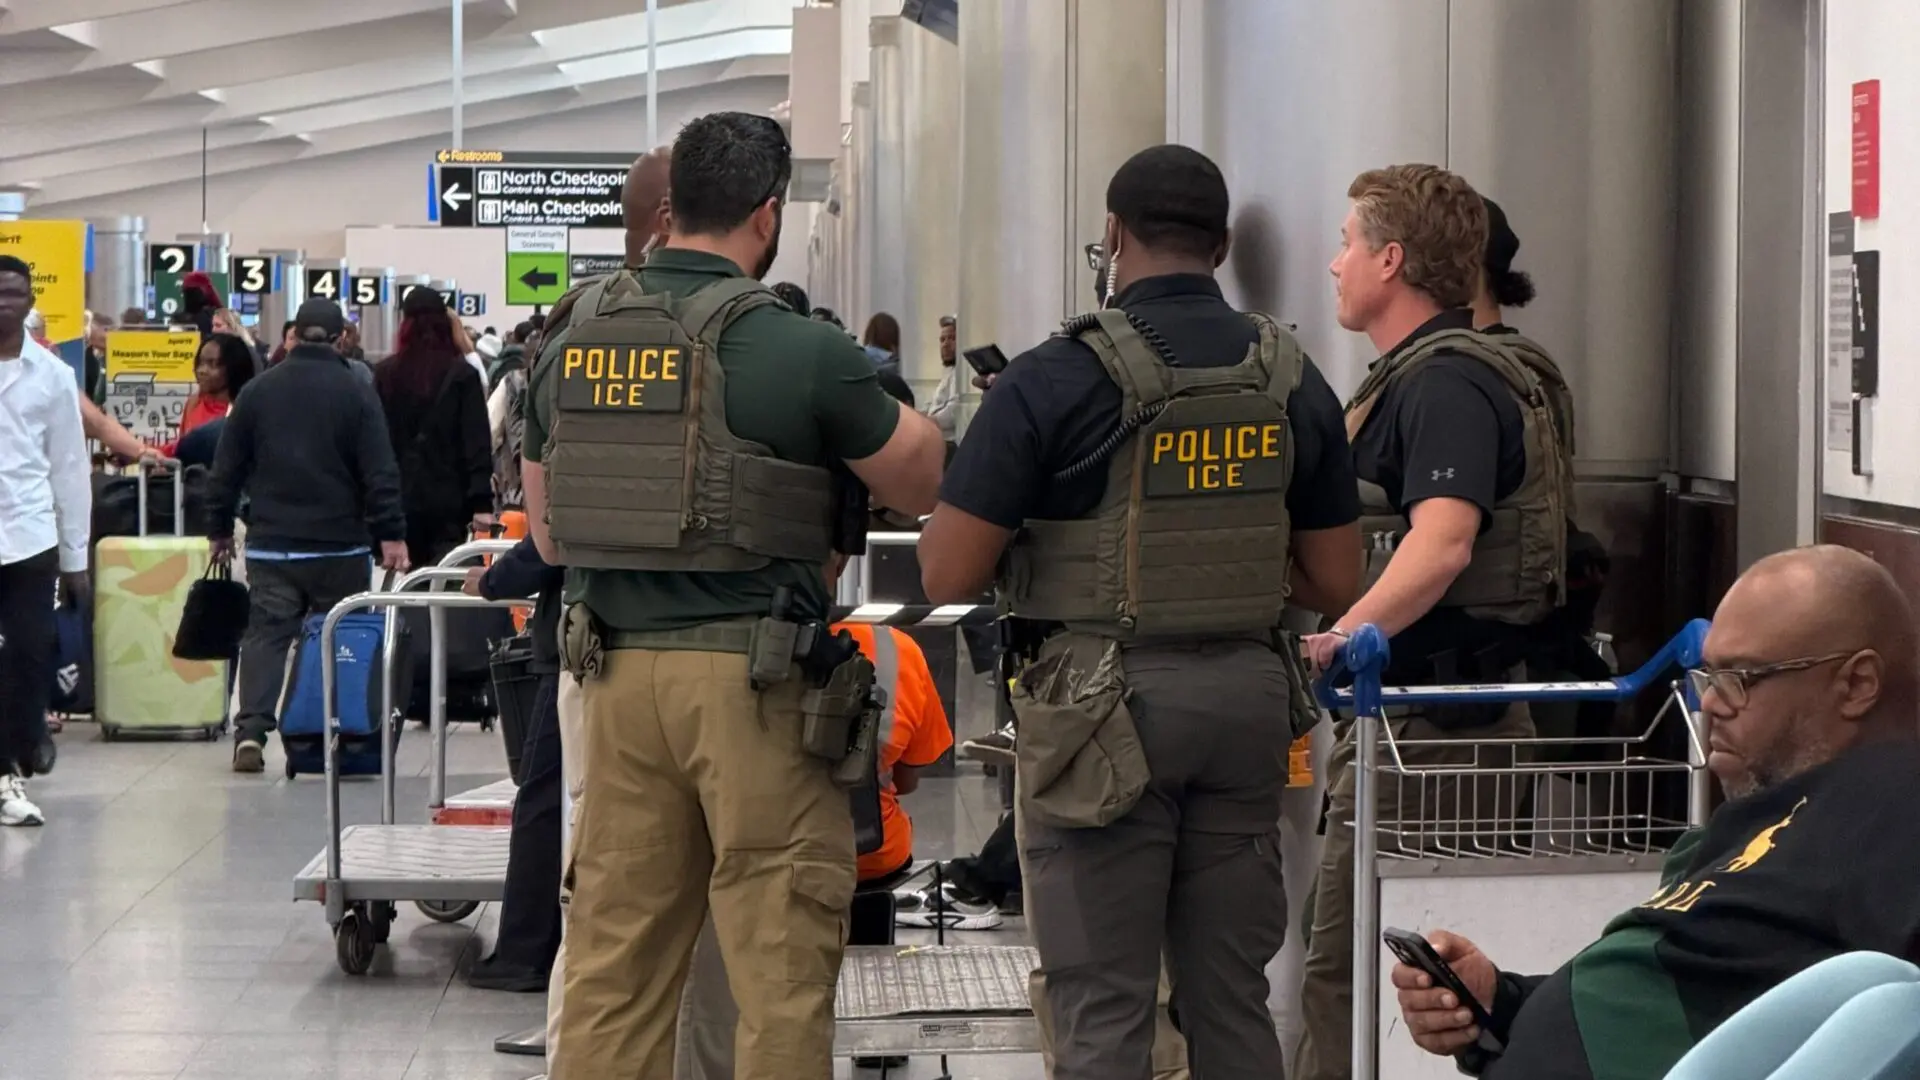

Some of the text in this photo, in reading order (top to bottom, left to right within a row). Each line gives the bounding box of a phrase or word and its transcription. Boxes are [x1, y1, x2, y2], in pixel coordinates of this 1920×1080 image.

[451, 151, 503, 162] Restrooms
[502, 171, 546, 185] North
[502, 186, 610, 196] Control de Seguridad Norte
[502, 200, 623, 217] Main Checkpoin
[502, 216, 586, 225] Control de Seguridad
[511, 230, 565, 240] General Security
[160, 247, 186, 273] 2
[241, 258, 265, 291] 3
[312, 271, 336, 298] 4
[356, 278, 376, 305] 5
[439, 292, 451, 304] 7
[462, 296, 476, 315] 8
[112, 350, 194, 360] Measure Your Bags
[563, 347, 681, 381] POLICE
[593, 383, 645, 406] ICE
[1152, 424, 1282, 465] POLICE
[1187, 463, 1244, 490] ICE
